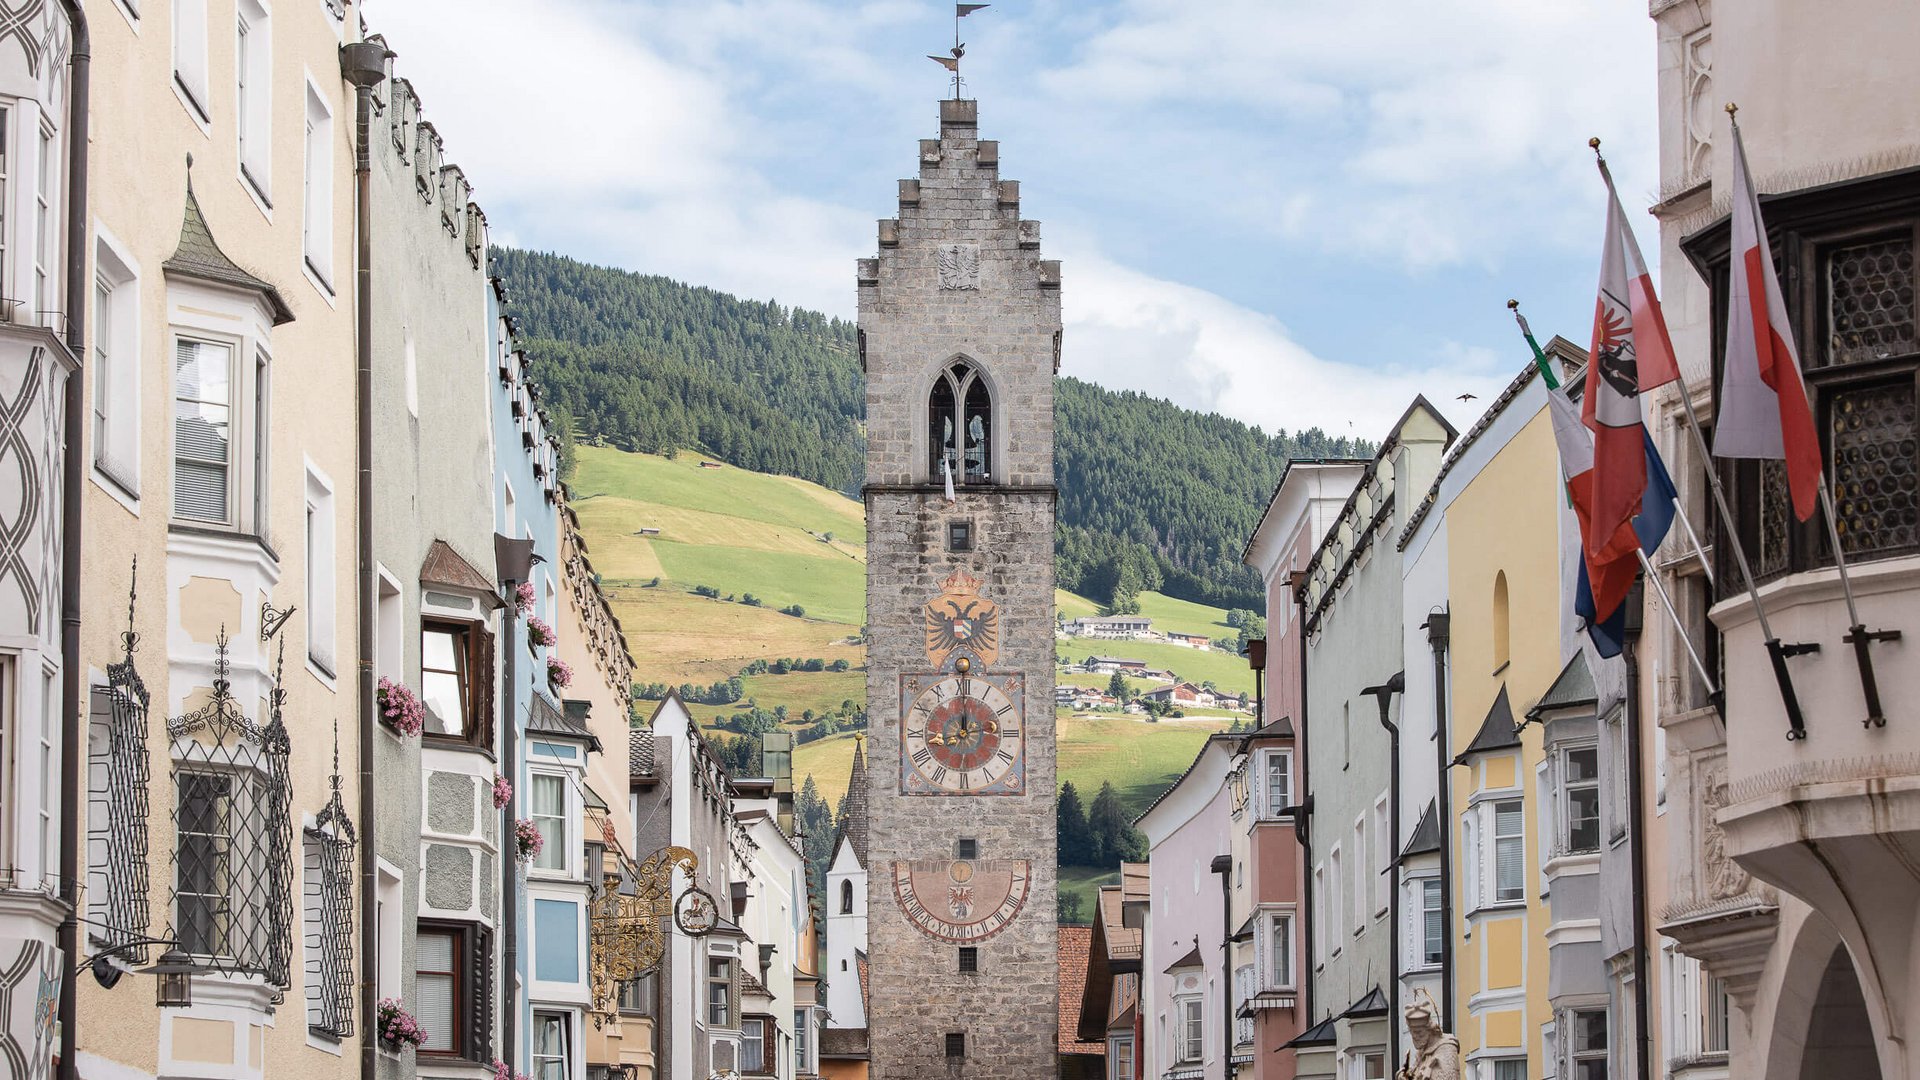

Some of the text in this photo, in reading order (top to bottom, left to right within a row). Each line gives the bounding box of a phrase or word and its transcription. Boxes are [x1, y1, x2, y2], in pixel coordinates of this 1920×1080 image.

[931, 684, 945, 702] XI
[955, 679, 971, 696] XII
[982, 685, 991, 700] I
[914, 702, 931, 718] X
[996, 703, 1013, 717] II
[907, 728, 924, 738] IX
[1002, 729, 1019, 738] III
[911, 747, 932, 768] VIII
[931, 765, 947, 785] VII
[959, 772, 969, 790] VI
[982, 767, 995, 784] V
[1012, 874, 1025, 883] V
[1005, 894, 1020, 909] IIII
[908, 902, 925, 919] VIII
[921, 914, 934, 928] IX
[993, 911, 1006, 925] III
[936, 921, 945, 935] X
[946, 925, 955, 937] XI
[955, 925, 966, 938] XII
[980, 921, 989, 933] II
